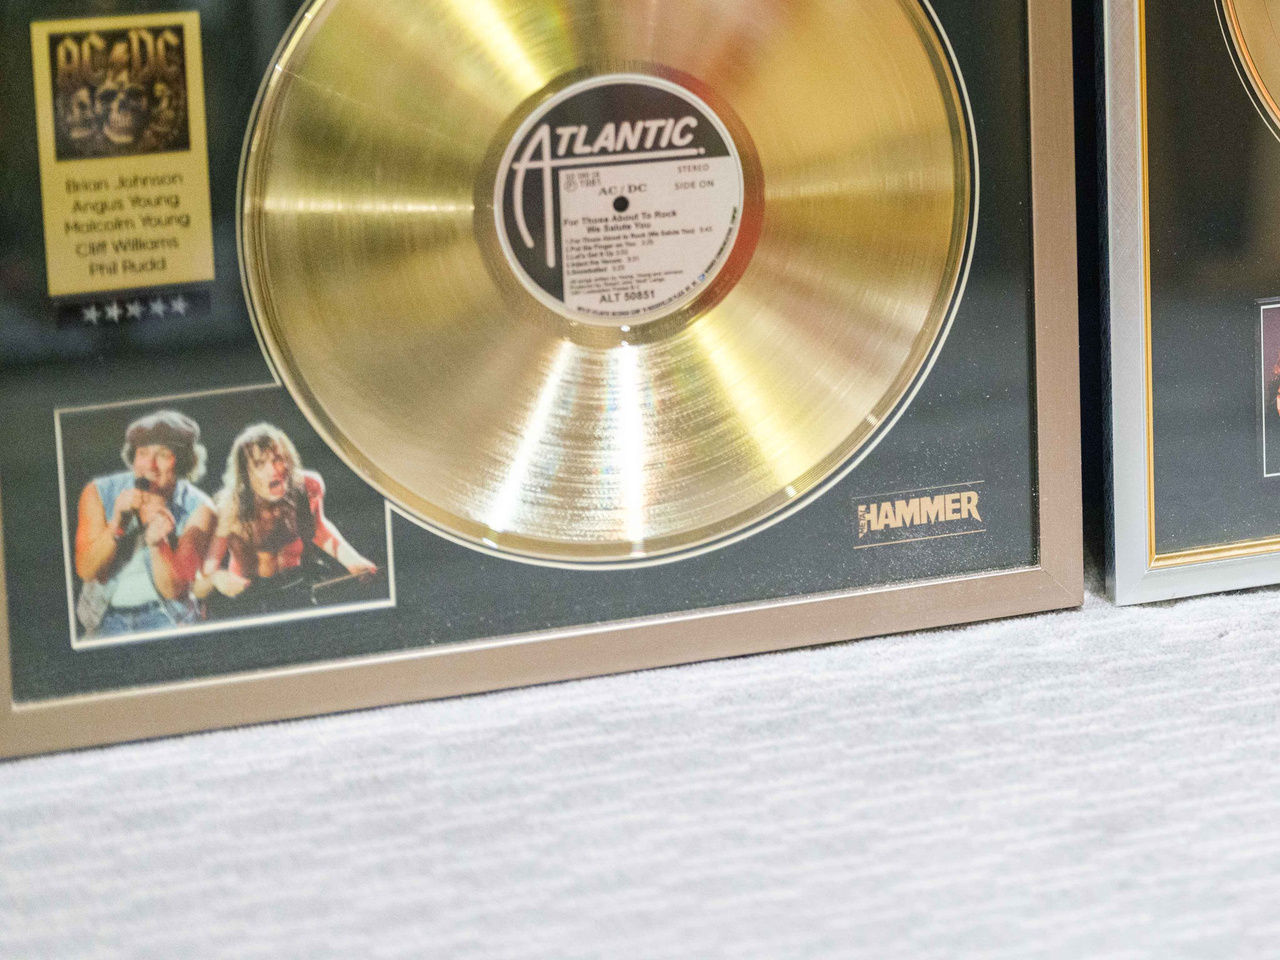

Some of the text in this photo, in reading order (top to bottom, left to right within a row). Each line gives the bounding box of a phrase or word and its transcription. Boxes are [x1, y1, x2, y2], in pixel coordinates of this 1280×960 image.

[677, 164, 710, 174] STEREO
[674, 180, 695, 190] SIDE
[72, 192, 181, 216] Angus Young
[600, 293, 620, 304] ALT
[865, 490, 983, 532] HAMMER
